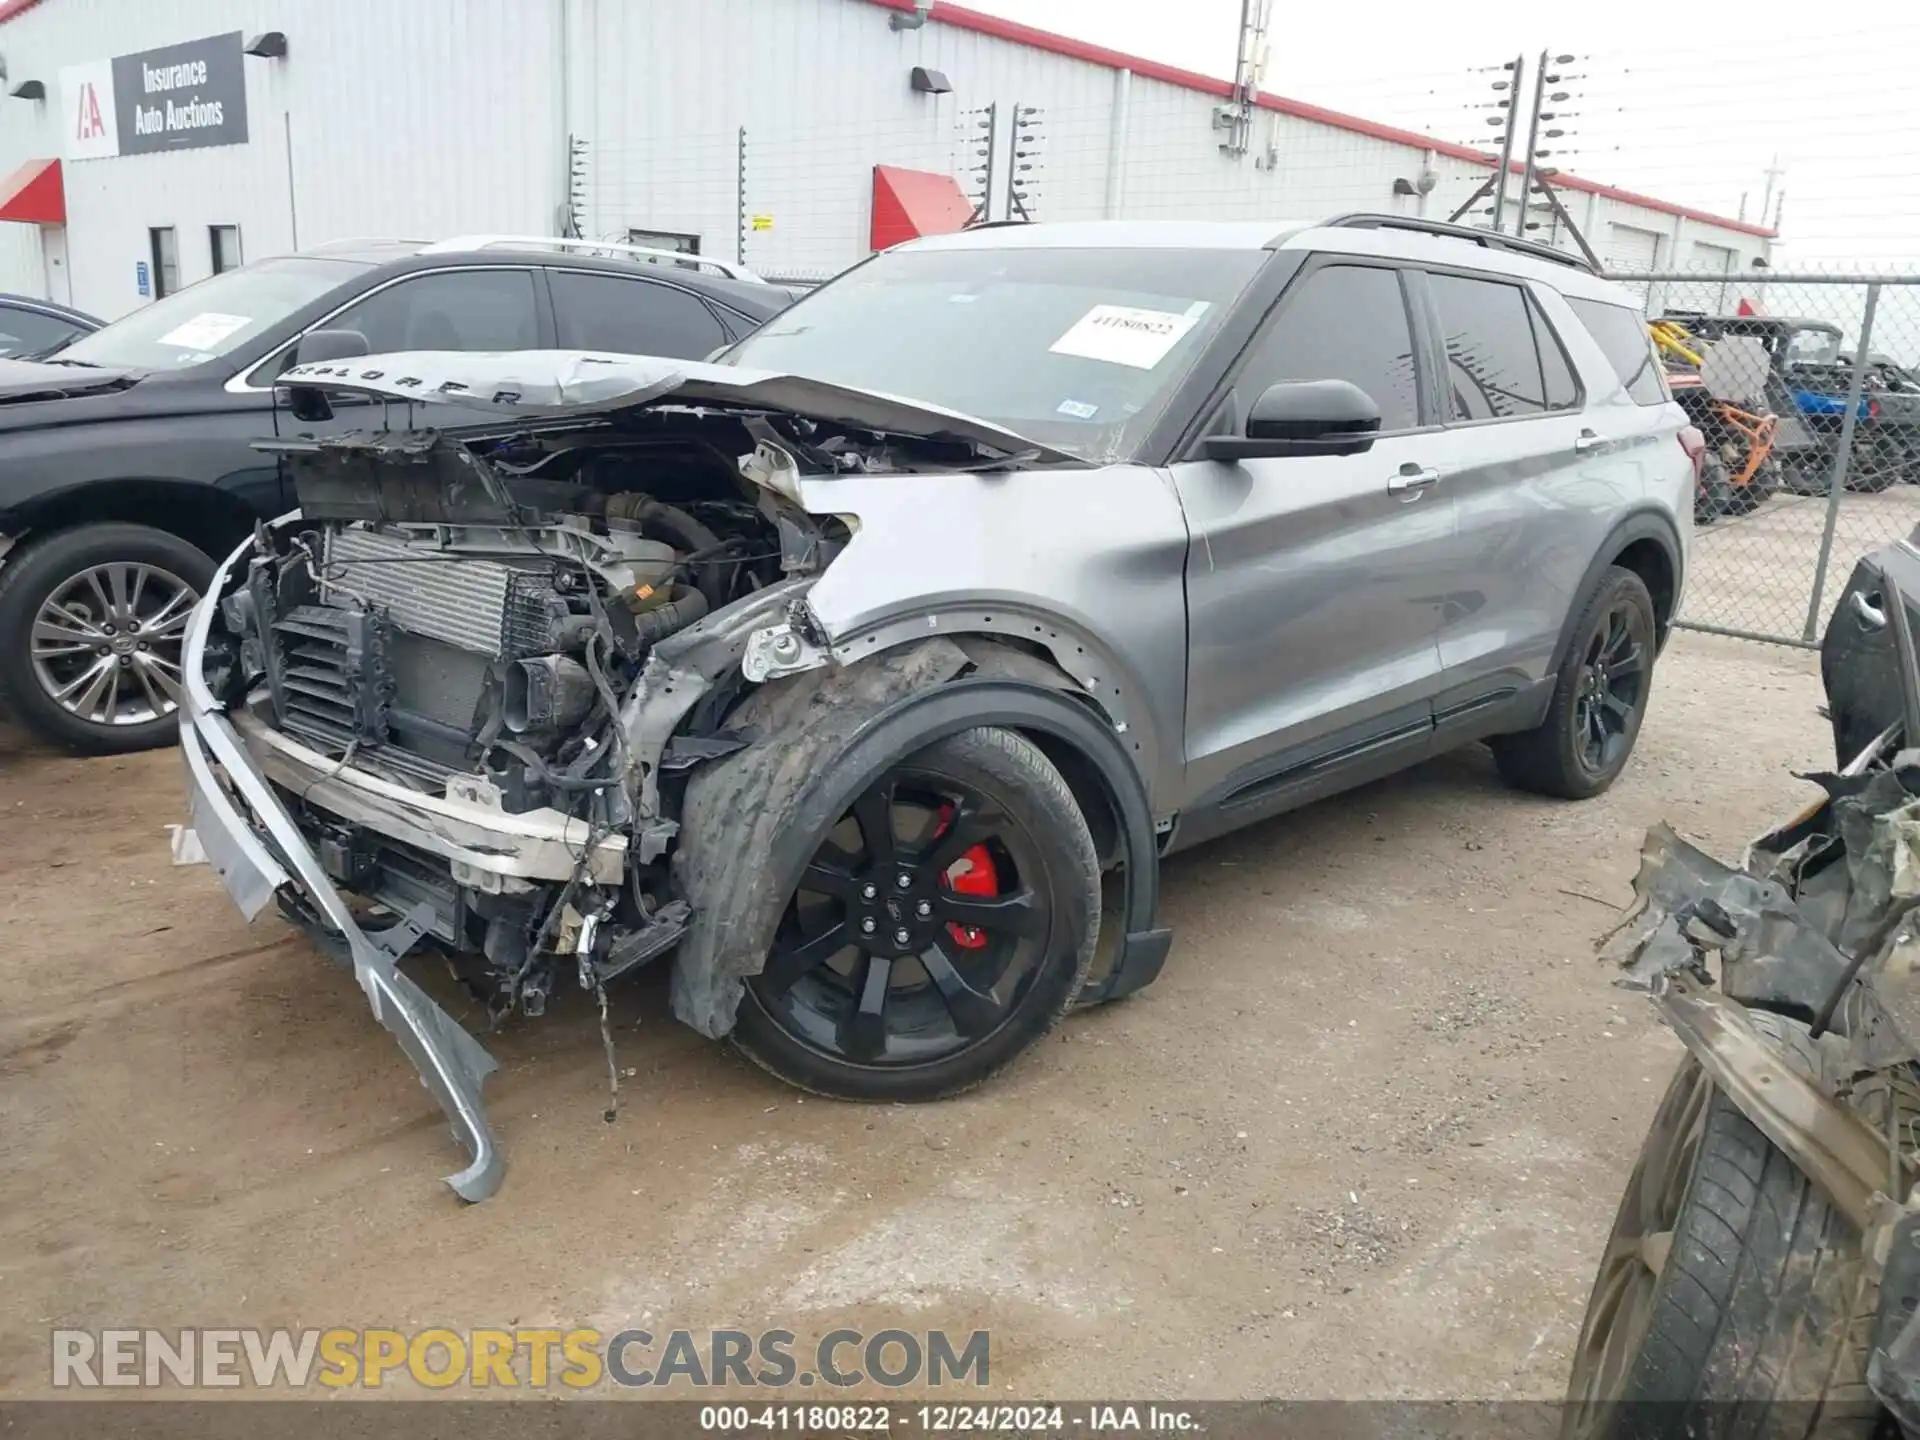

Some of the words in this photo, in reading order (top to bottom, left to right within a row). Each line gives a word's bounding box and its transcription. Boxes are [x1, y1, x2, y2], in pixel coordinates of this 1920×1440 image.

[143, 61, 207, 93] Insurance
[135, 104, 163, 135] Auto
[166, 95, 224, 131] Auctions
